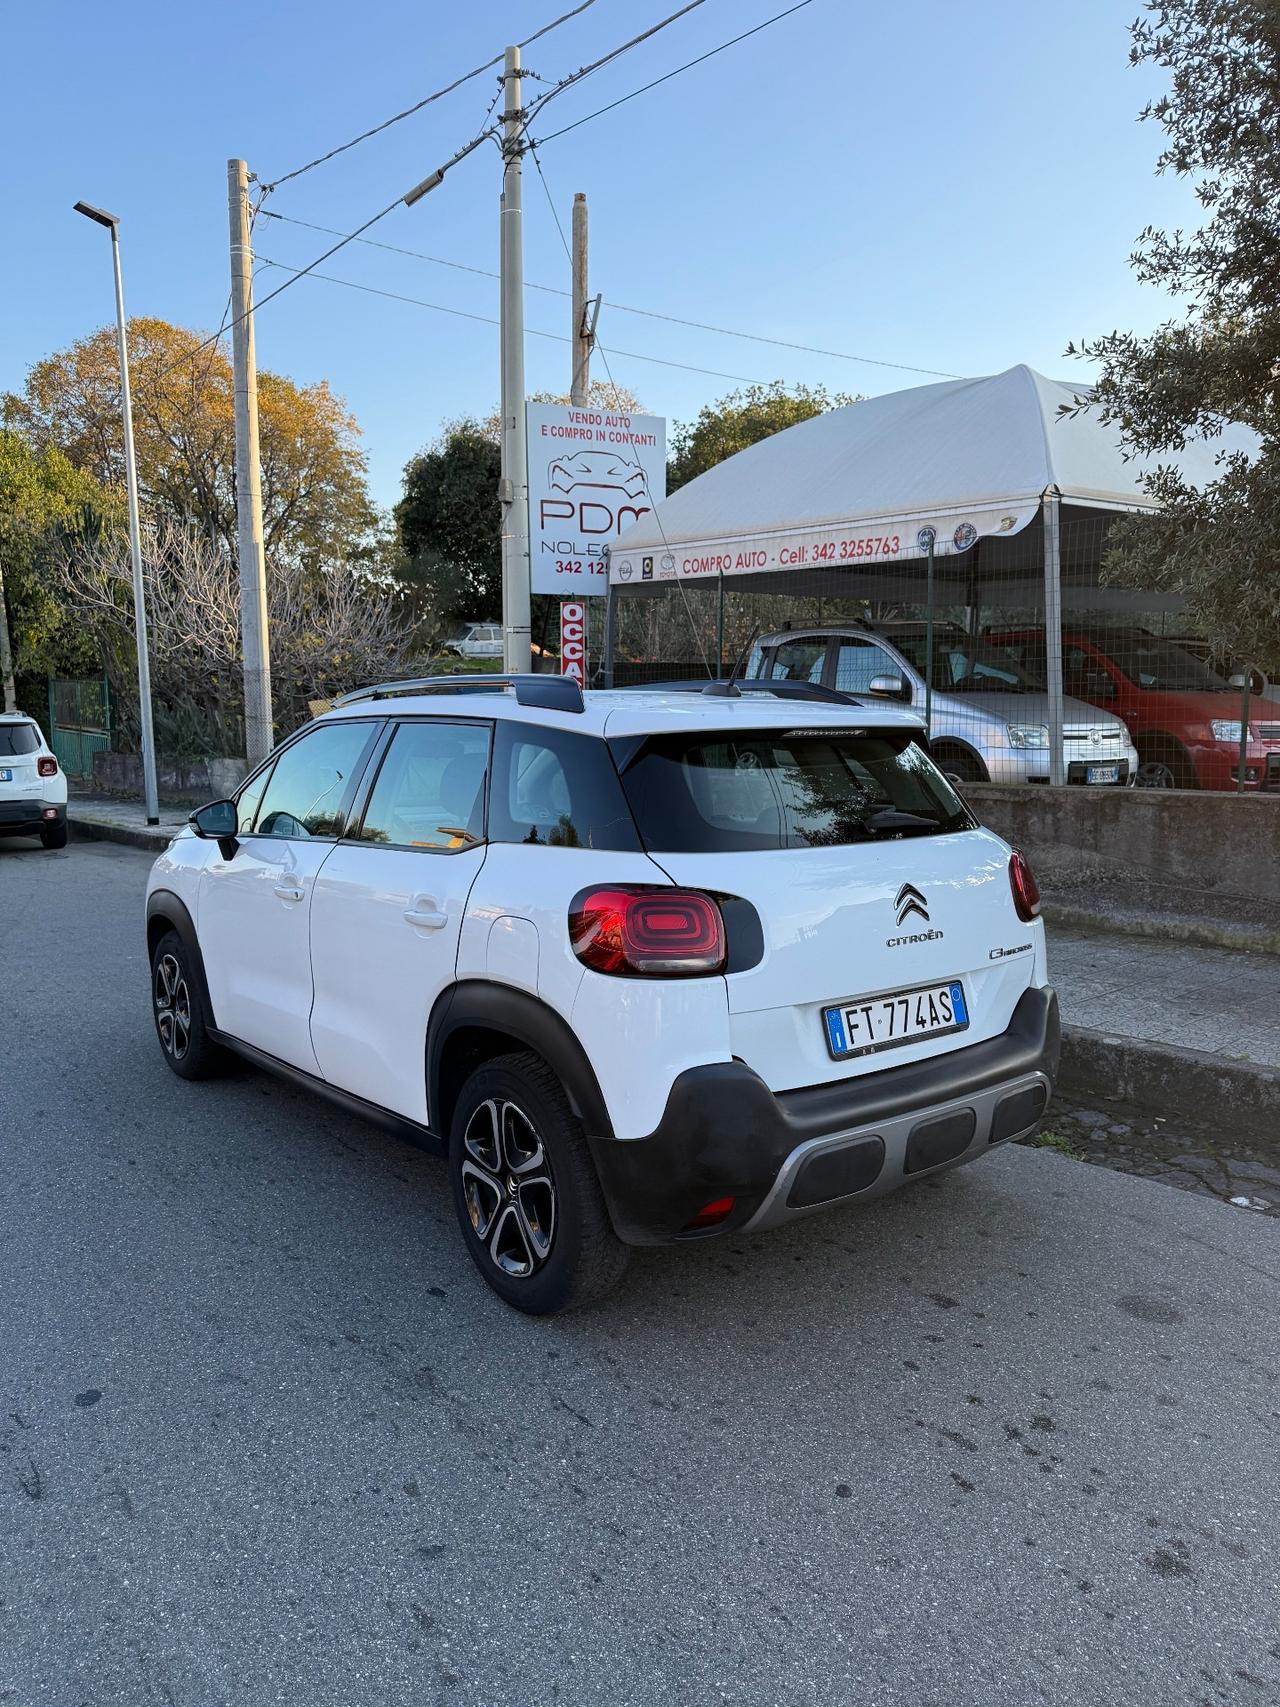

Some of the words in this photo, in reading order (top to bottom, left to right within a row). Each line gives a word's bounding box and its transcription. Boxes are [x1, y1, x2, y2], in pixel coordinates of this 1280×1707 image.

[568, 411, 601, 425] VENDO
[605, 417, 631, 428] AUTO
[541, 425, 547, 436] E
[550, 426, 592, 440] COMPRO
[596, 431, 606, 442] IN
[609, 432, 656, 446] CONTANTI
[682, 554, 732, 574] COMPRO
[735, 550, 767, 569] AUTO
[779, 546, 808, 564] Cell:
[812, 543, 836, 561] 342
[840, 536, 900, 559] 3255763
[555, 560, 582, 574] 342
[587, 562, 608, 575] 12
[563, 604, 583, 686] OCCA
[886, 929, 944, 948] CITROËN
